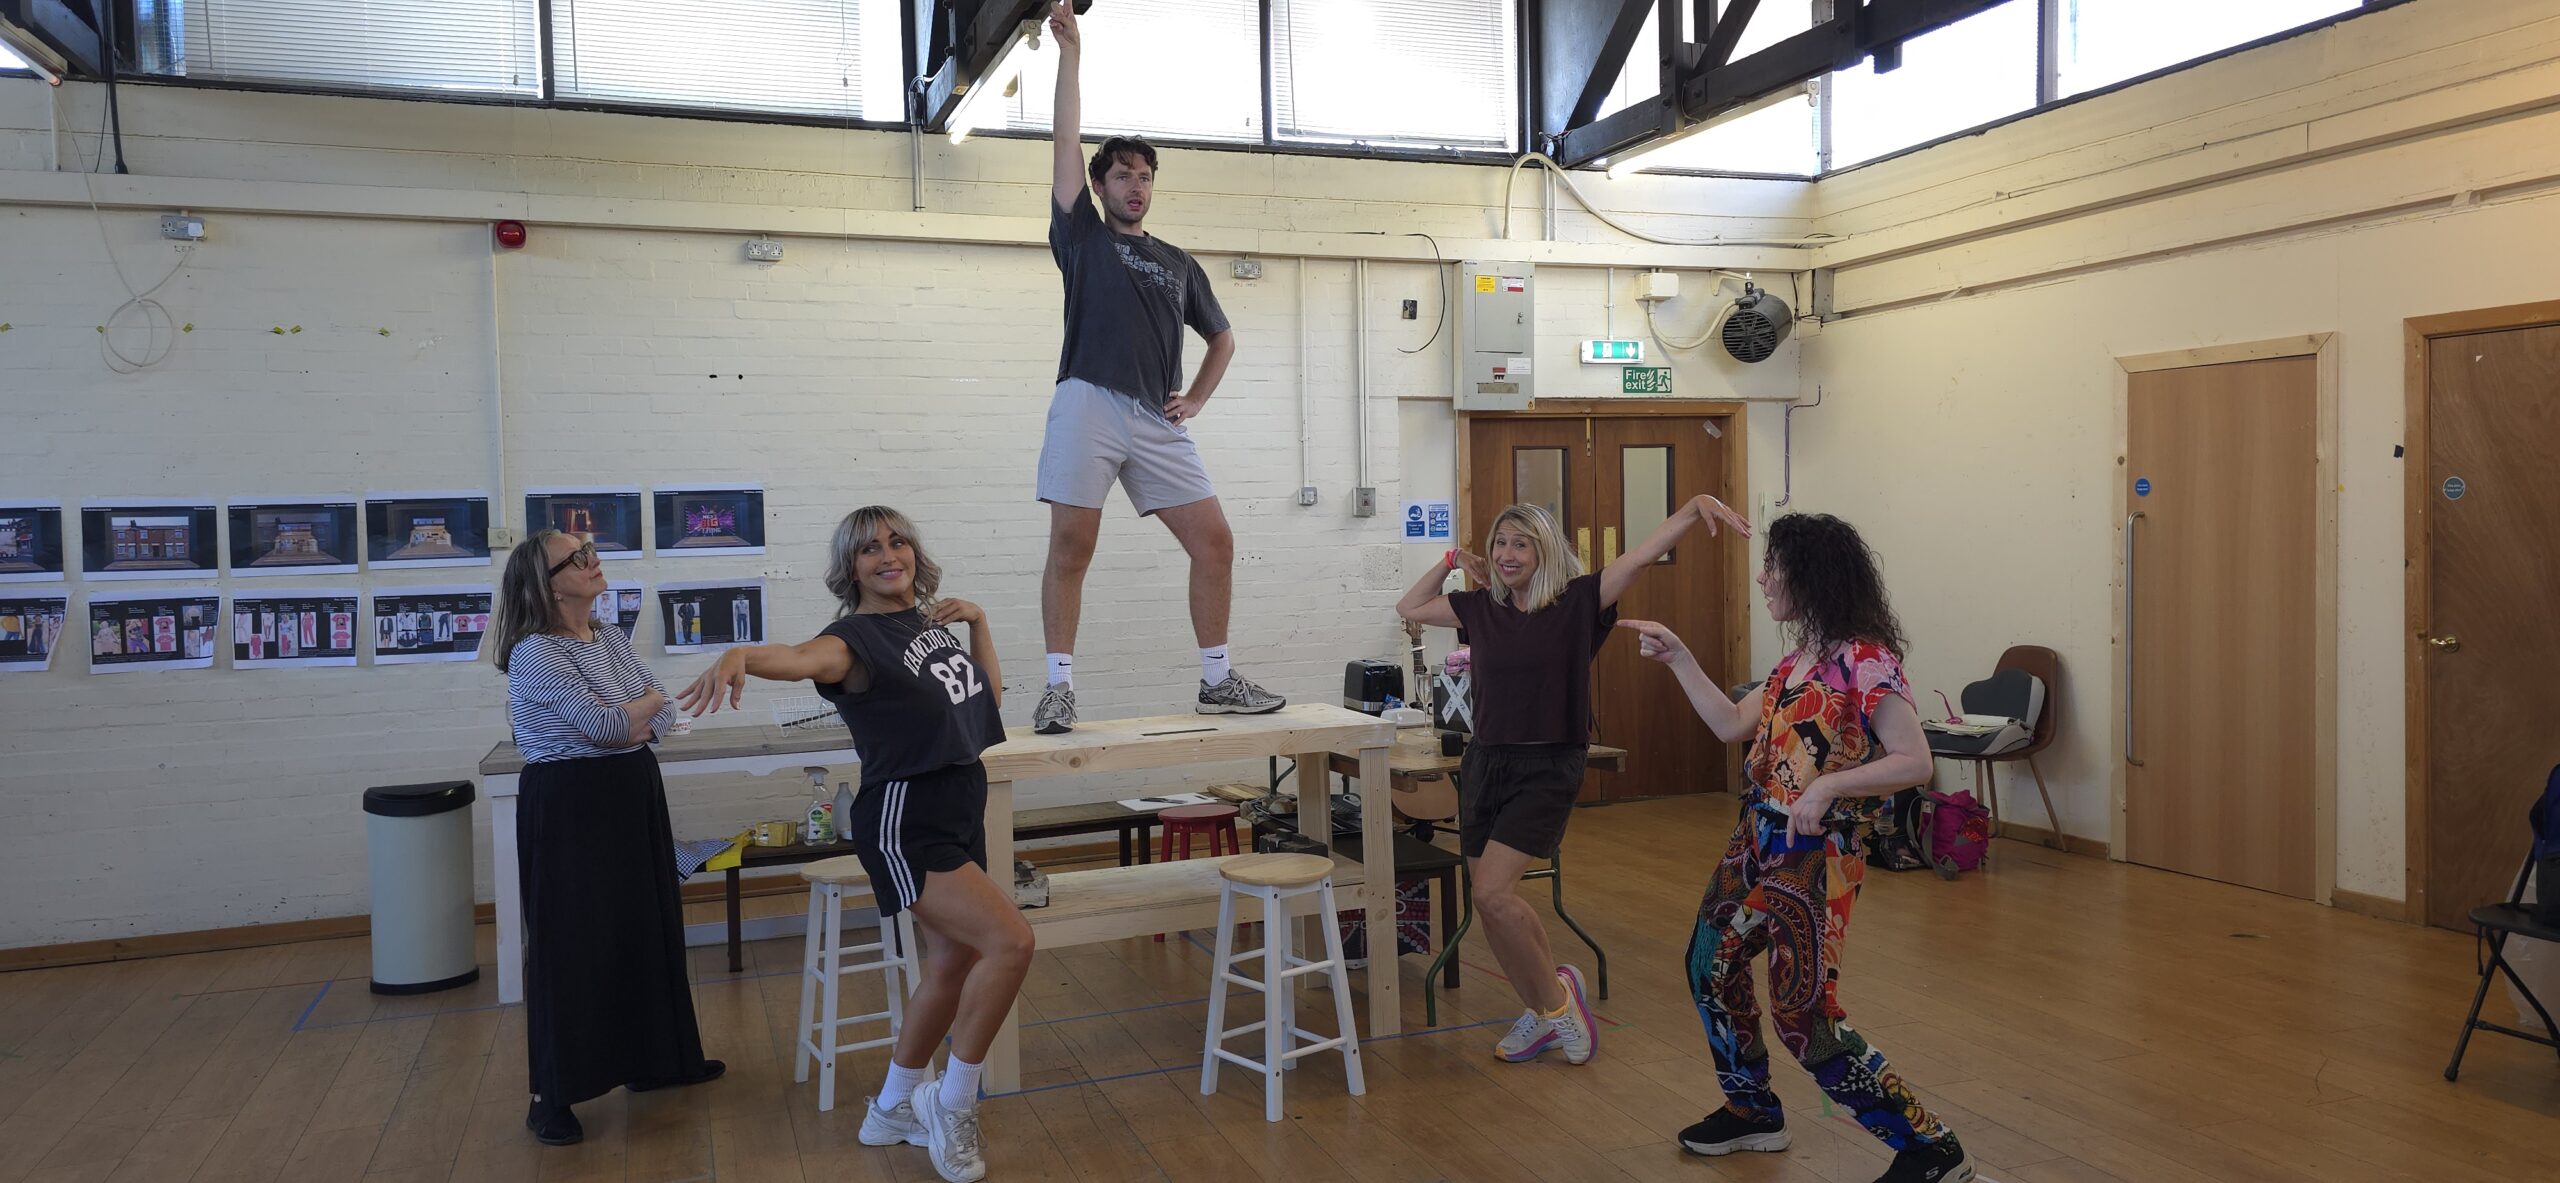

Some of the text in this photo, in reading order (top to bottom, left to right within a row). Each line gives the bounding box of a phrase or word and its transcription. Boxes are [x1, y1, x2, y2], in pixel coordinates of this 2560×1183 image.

[1625, 369, 1647, 380] Fire
[1625, 380, 1646, 390] exit
[701, 518, 719, 528] BIG
[930, 653, 983, 705] 82
